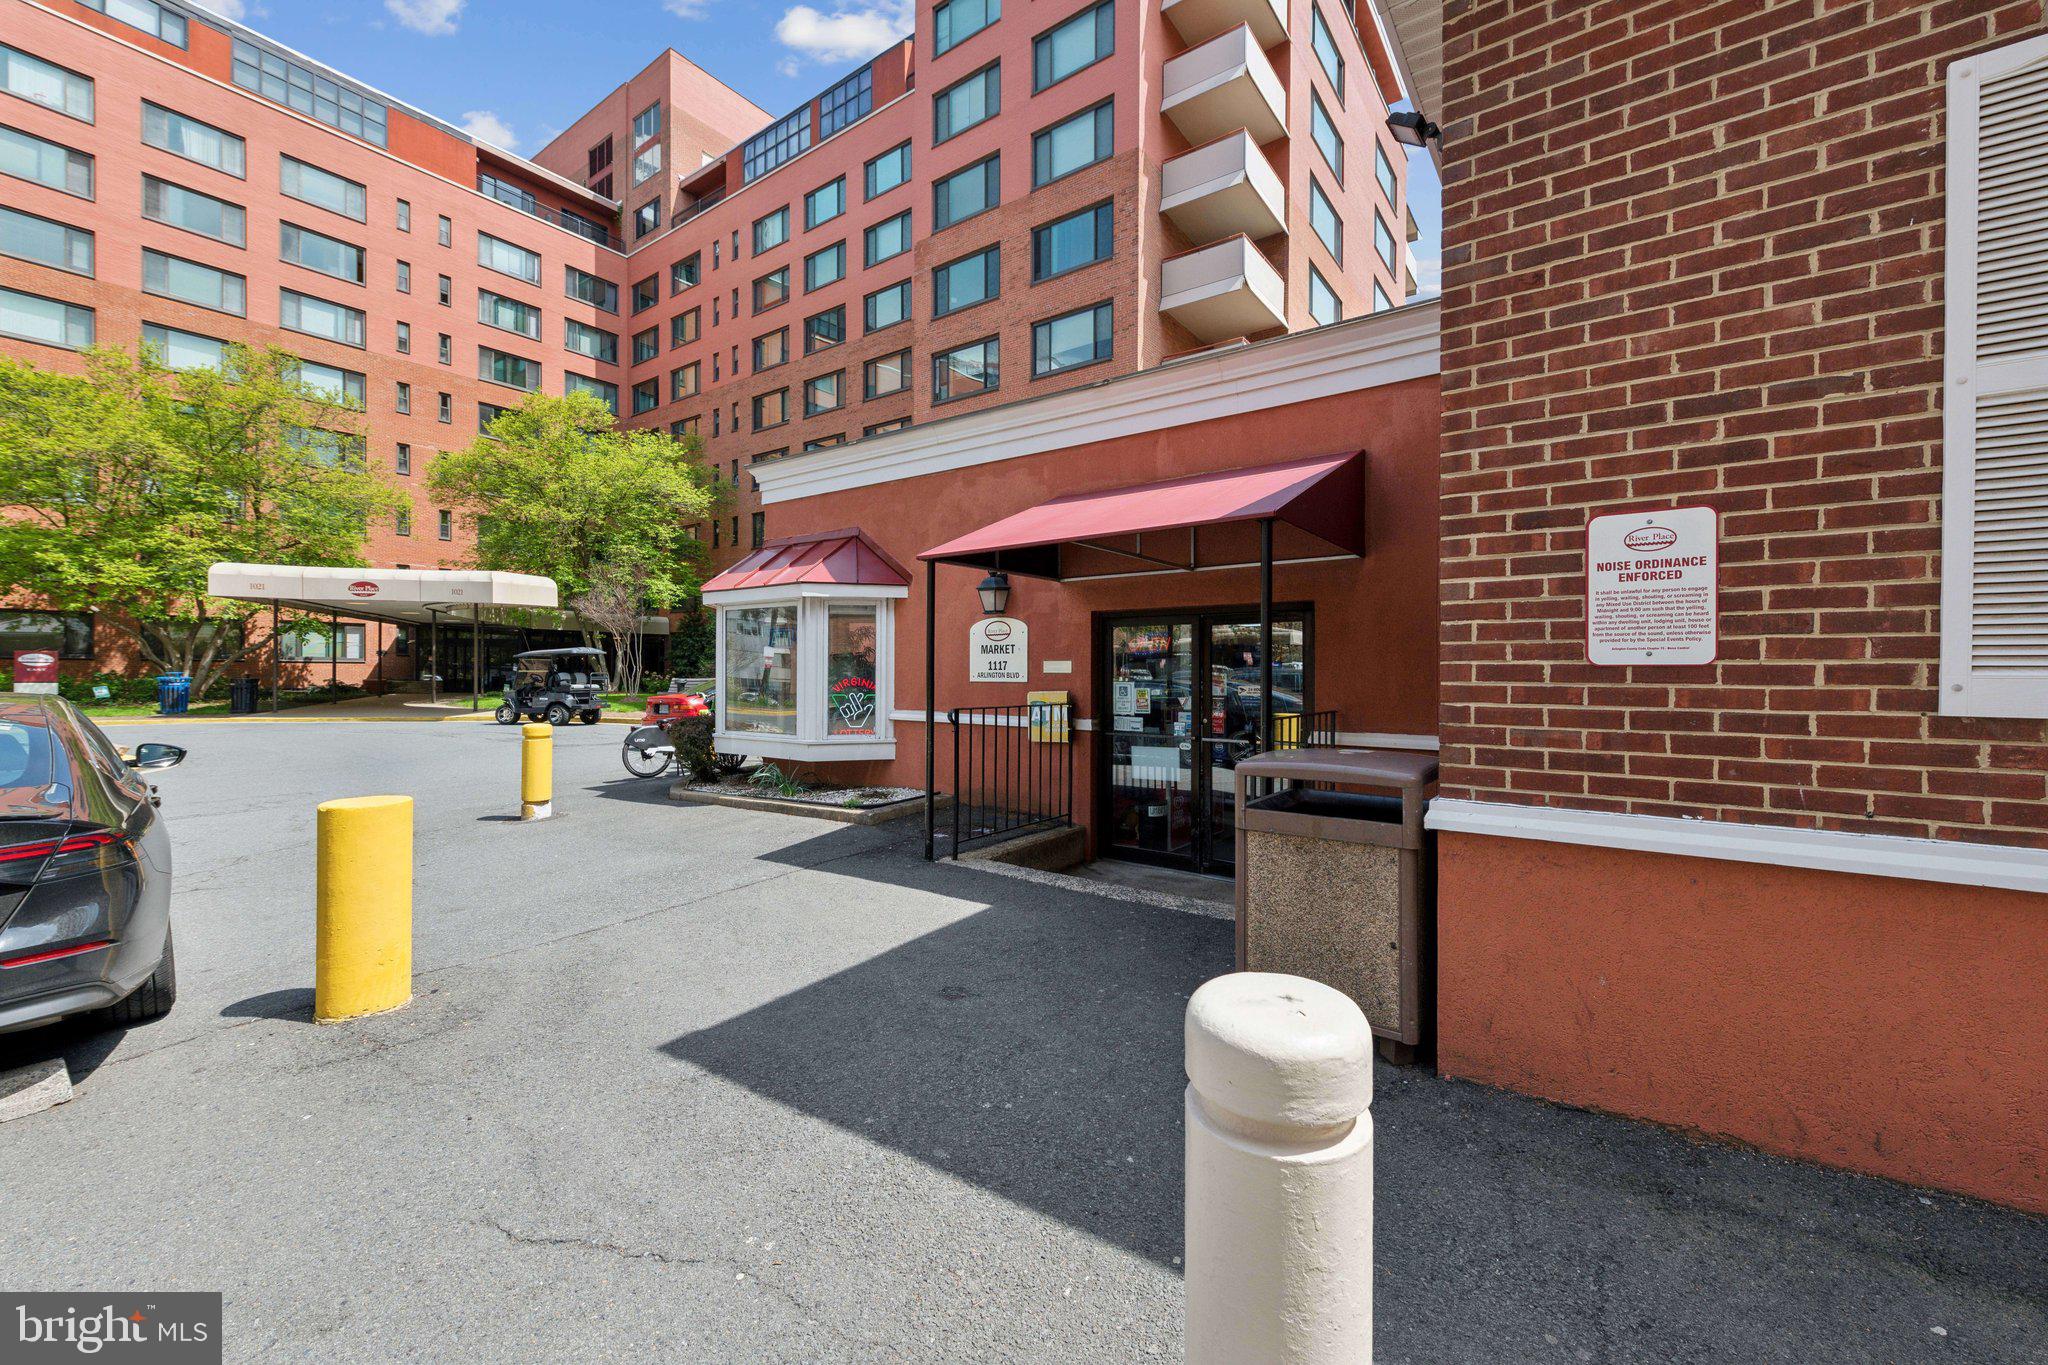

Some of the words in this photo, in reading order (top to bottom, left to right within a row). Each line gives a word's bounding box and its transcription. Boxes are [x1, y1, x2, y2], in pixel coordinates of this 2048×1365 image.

[1628, 534, 1648, 542] River
[1653, 532, 1674, 540] Place
[1596, 560, 1631, 572] NOISE
[1635, 556, 1707, 570] ORDINANCE
[1618, 570, 1682, 582] ENFORCED
[981, 644, 1015, 654] MARKET
[988, 661, 1007, 670] 1117
